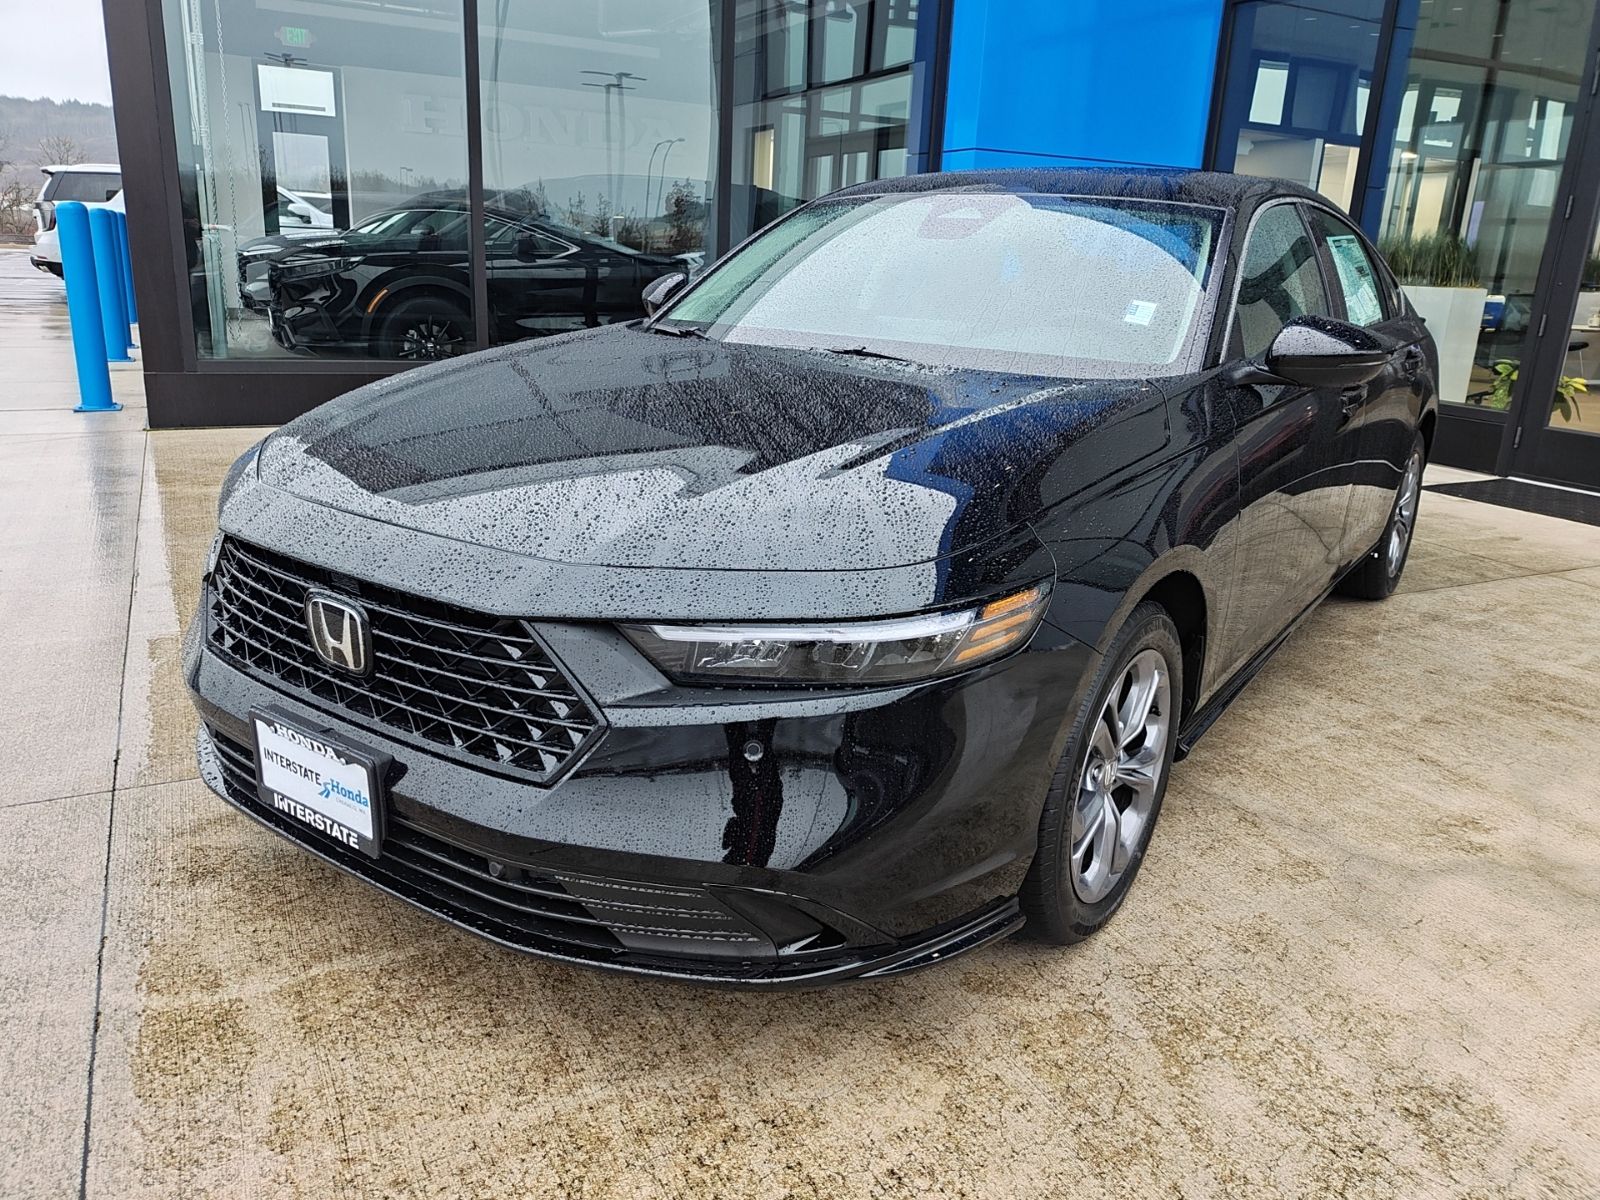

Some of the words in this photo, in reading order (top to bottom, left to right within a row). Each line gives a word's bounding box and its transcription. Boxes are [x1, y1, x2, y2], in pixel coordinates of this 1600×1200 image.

[273, 722, 339, 762] HONDA
[263, 747, 322, 786] INTERSTATE
[330, 778, 369, 808] Honda
[273, 792, 360, 850] INTERSTATE
